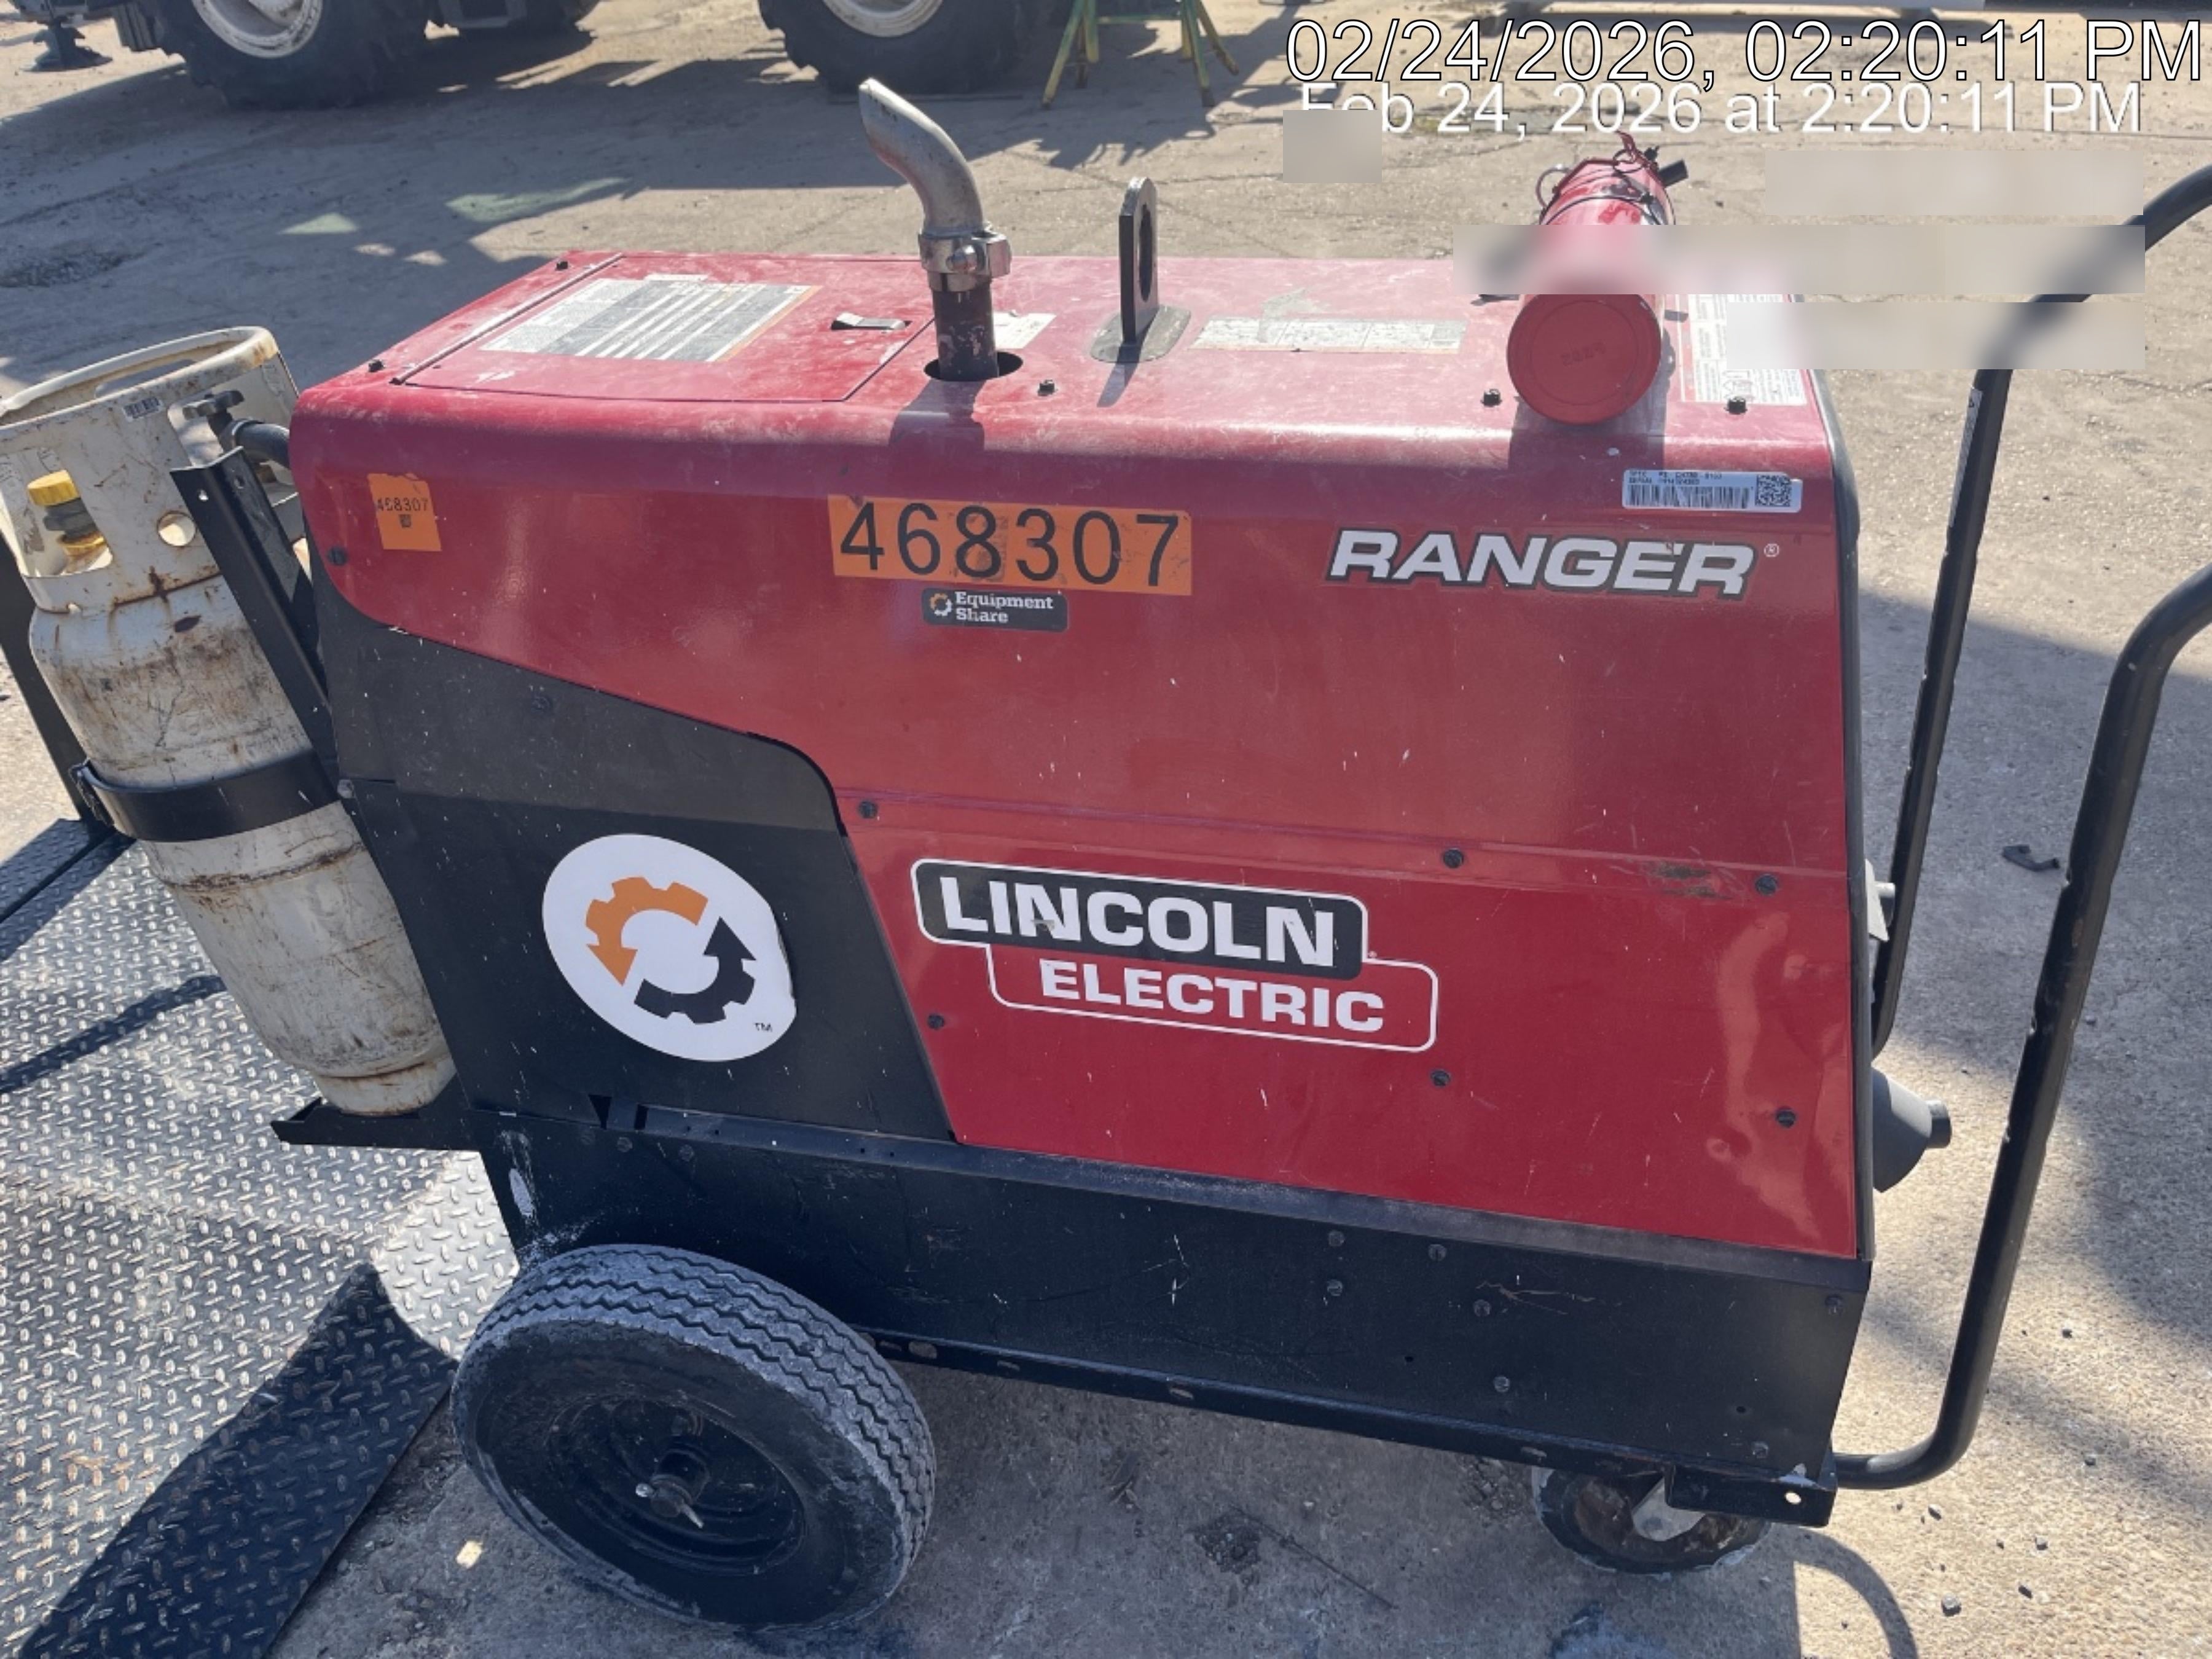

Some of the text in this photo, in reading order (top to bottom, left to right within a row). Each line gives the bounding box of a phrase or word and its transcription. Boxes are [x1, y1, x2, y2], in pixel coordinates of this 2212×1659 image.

[840, 502, 1179, 587] 468307
[1327, 528, 1756, 598] RANGER
[954, 591, 1053, 609] Equipment
[955, 608, 1008, 623] Share
[940, 876, 1336, 968] LINCOLN
[1039, 959, 1384, 1033] ELECTRIC
